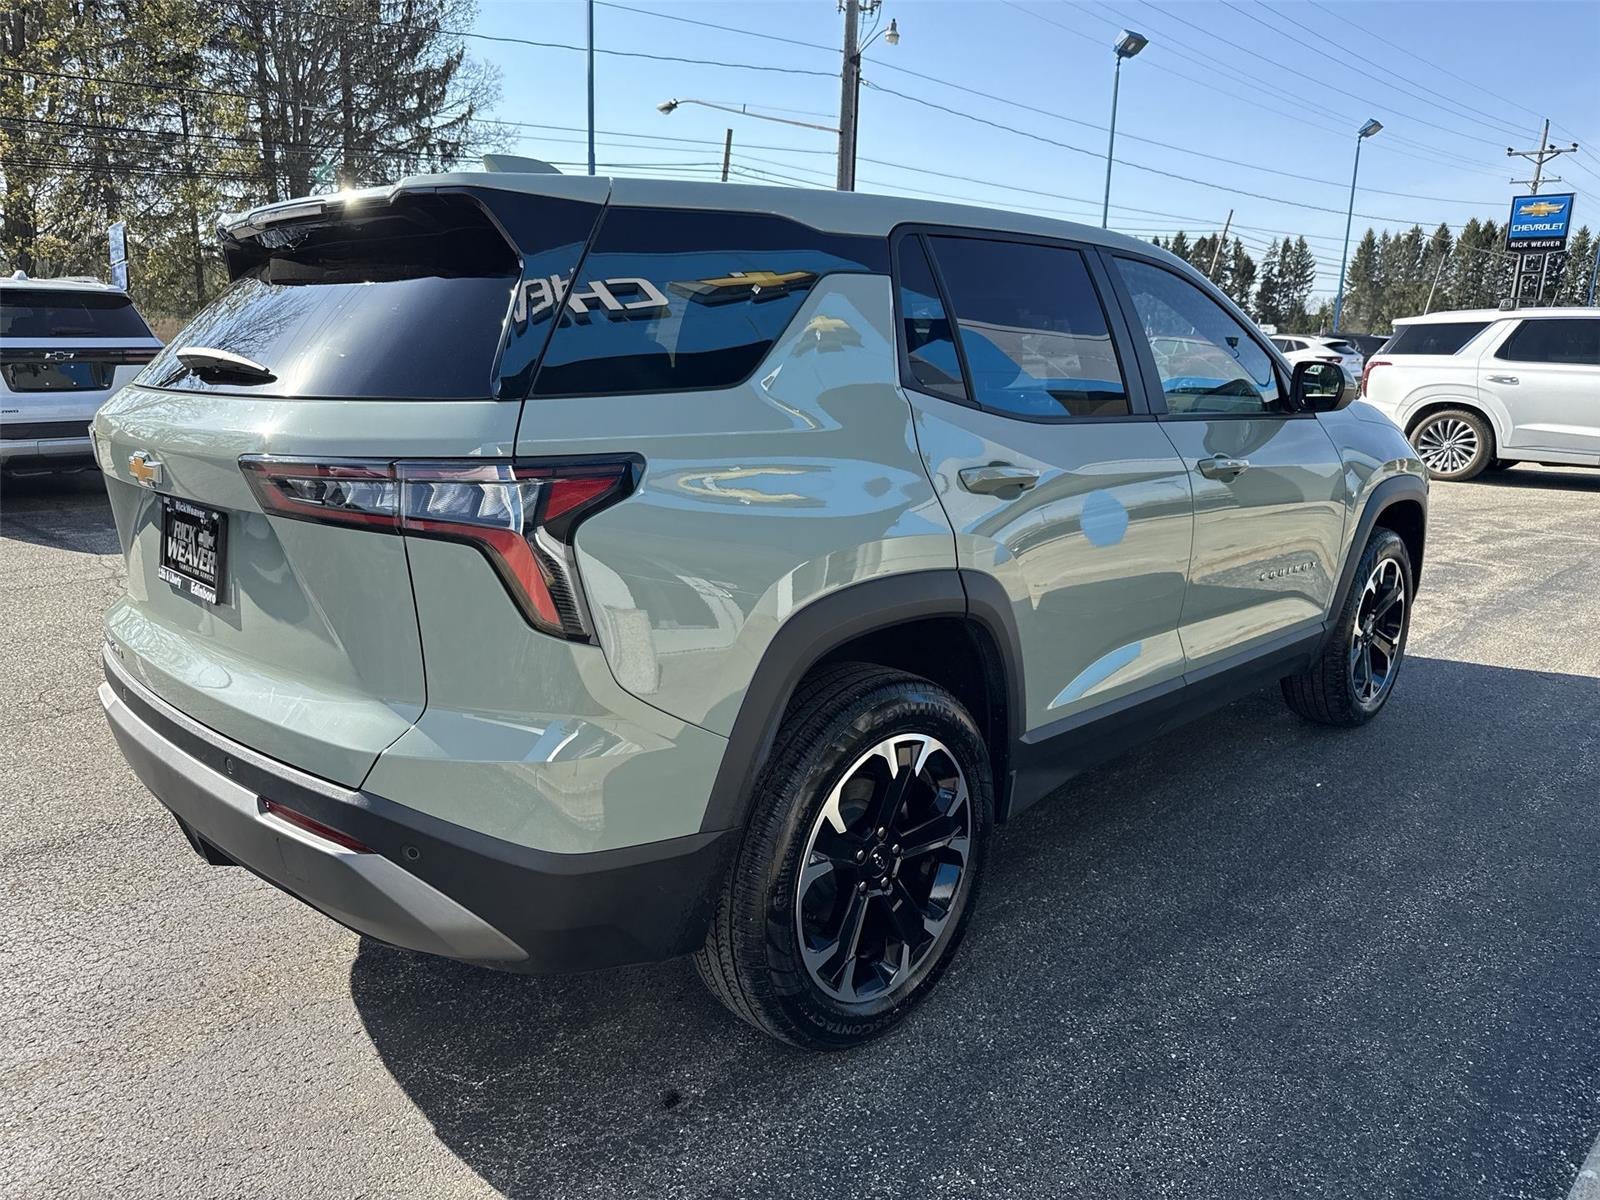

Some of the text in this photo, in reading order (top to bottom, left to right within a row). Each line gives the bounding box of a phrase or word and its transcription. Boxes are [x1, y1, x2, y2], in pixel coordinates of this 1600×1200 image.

[1512, 222, 1564, 232] CHEVROLET
[1530, 240, 1560, 248] WEAVER
[173, 520, 197, 545] RICK
[167, 536, 216, 575] WEAVER
